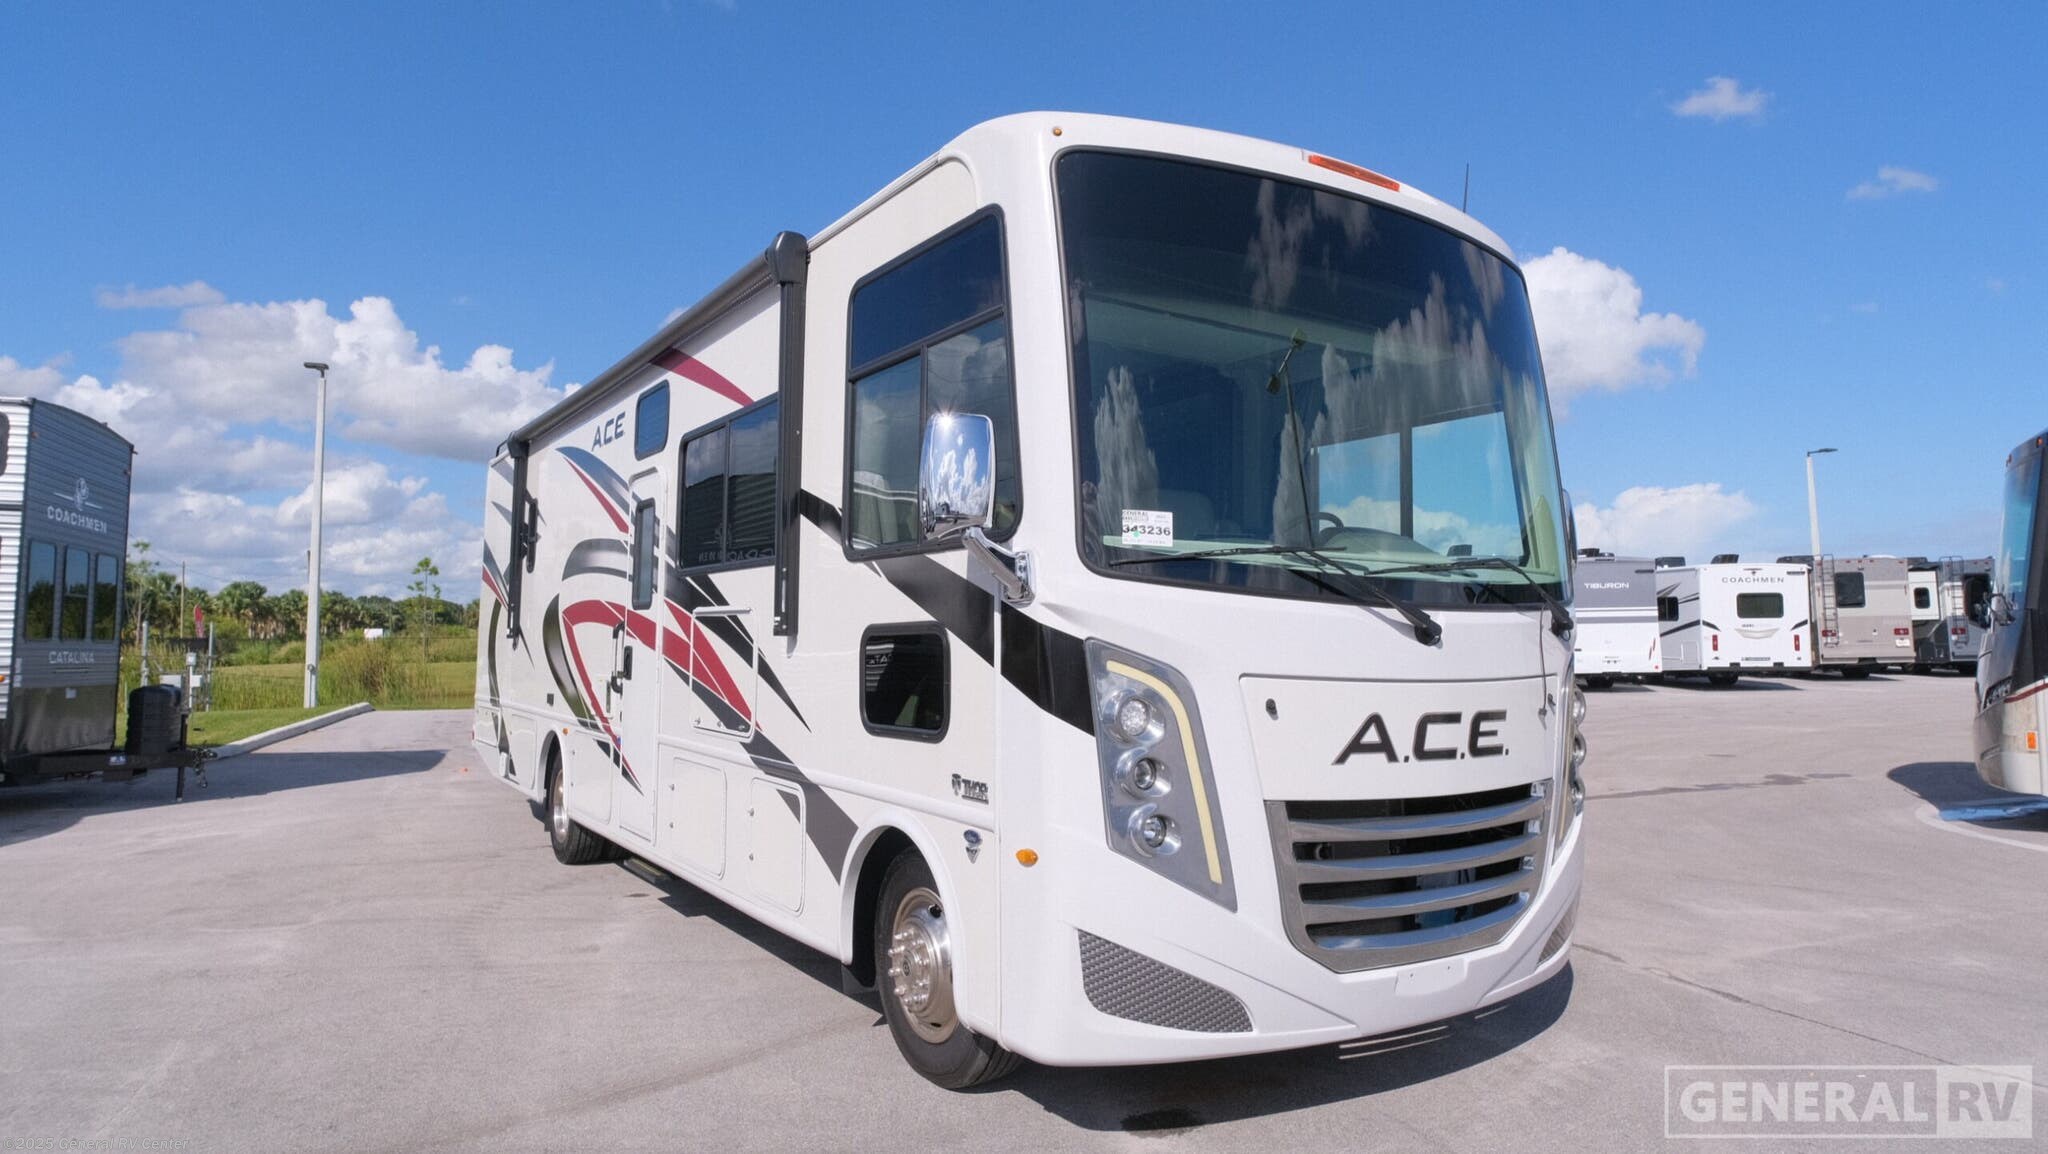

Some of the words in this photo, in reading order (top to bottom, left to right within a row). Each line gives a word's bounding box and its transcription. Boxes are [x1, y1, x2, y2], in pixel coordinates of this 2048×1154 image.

[591, 411, 626, 452] ACE
[47, 505, 107, 534] COACHMEN
[1122, 524, 1171, 536] 343236
[48, 650, 95, 664] CATALINA
